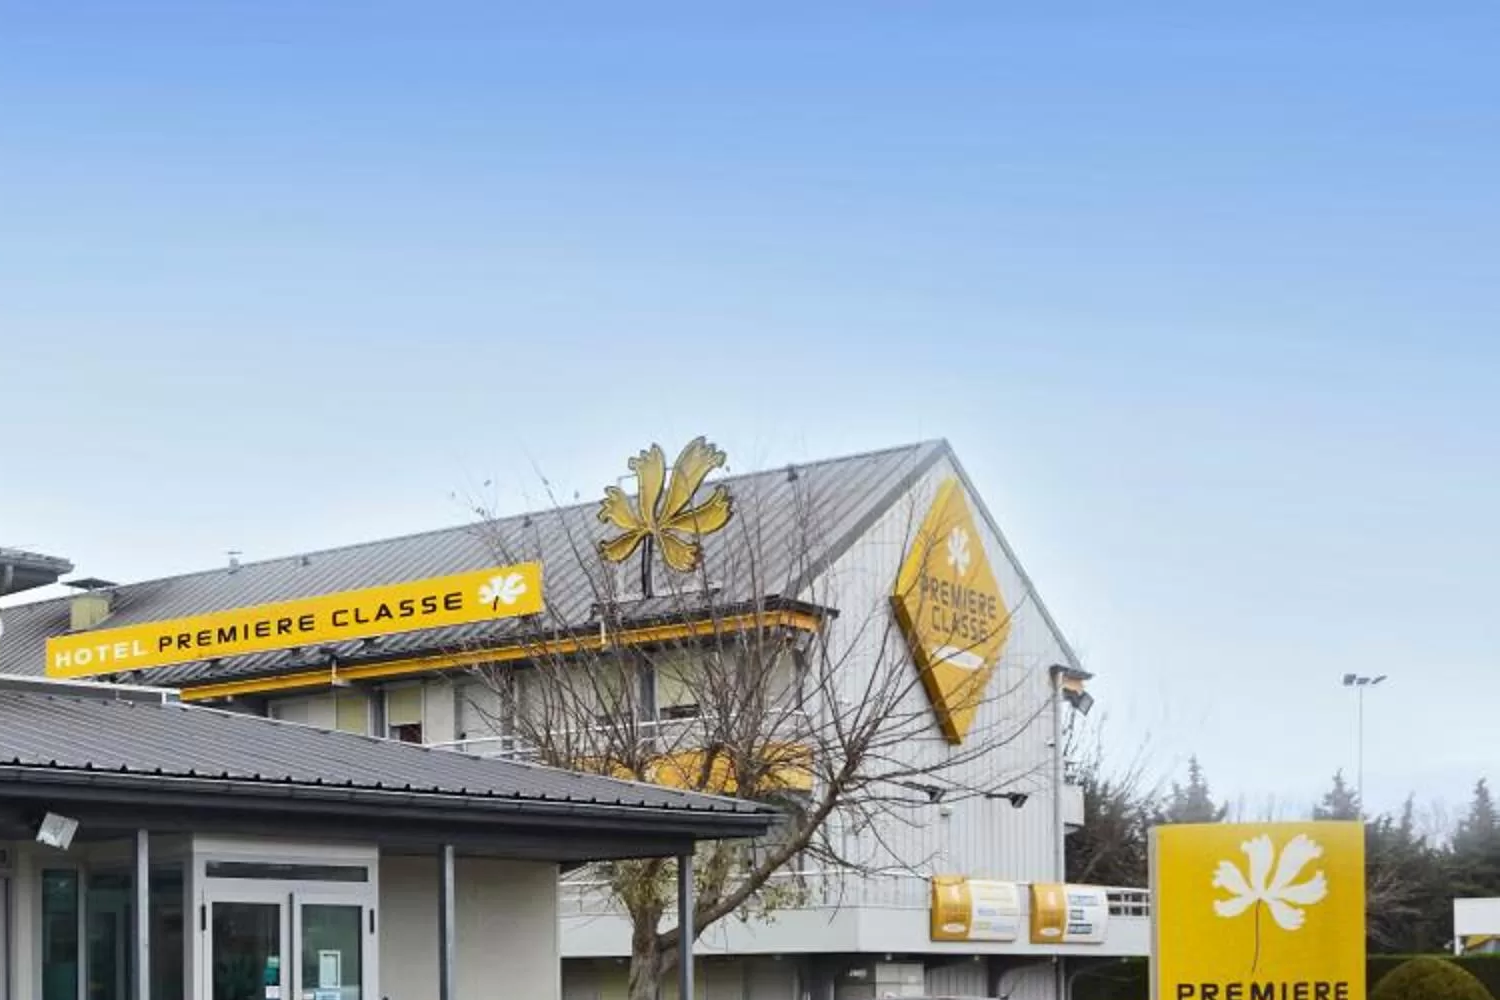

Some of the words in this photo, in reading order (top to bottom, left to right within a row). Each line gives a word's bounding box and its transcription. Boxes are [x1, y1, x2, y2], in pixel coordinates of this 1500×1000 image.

[55, 640, 149, 669] HOTEL
[158, 614, 317, 654] PREMIERE
[331, 591, 465, 628] CLASSE
[931, 605, 988, 643] CLASSE
